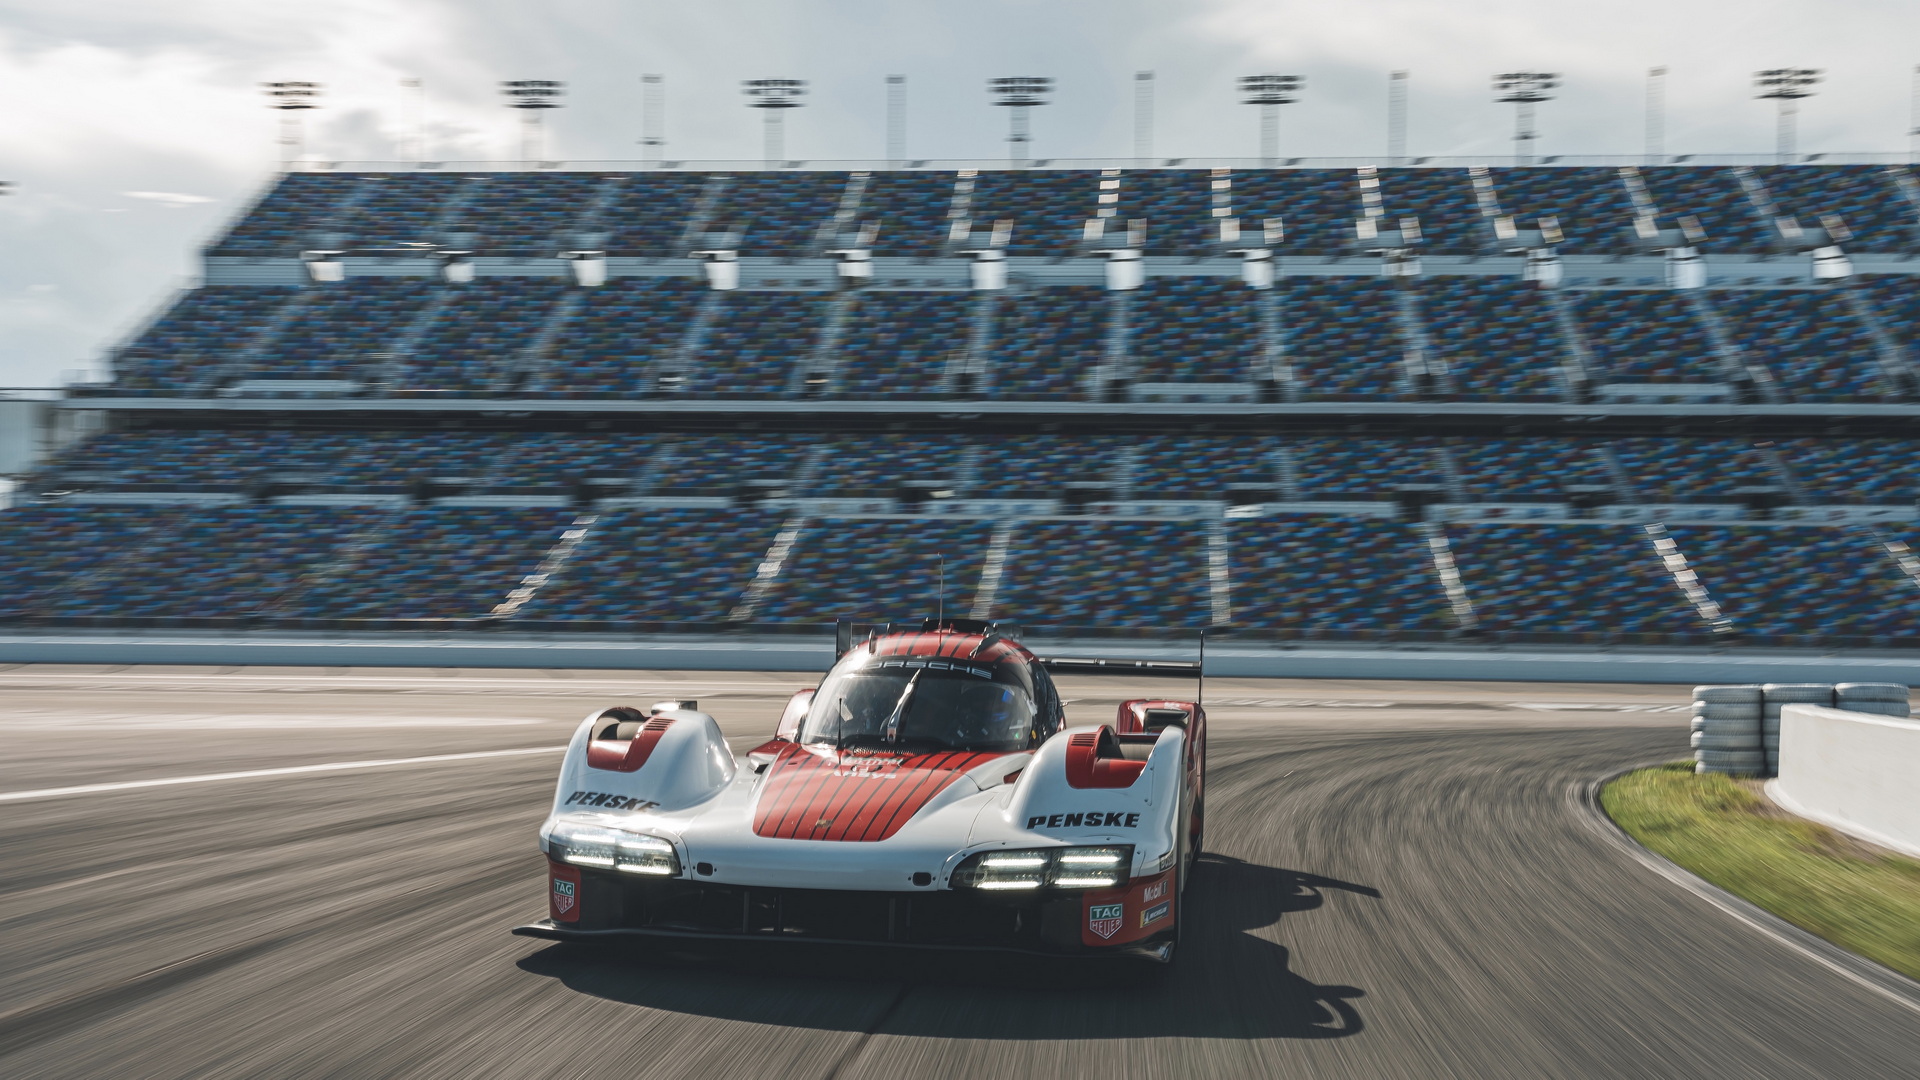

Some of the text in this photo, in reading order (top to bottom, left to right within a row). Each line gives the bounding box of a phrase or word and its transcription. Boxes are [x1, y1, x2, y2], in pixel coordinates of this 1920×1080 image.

[564, 791, 661, 812] PENSKE
[1026, 812, 1141, 830] PENSKE
[555, 881, 573, 895] TAG
[1143, 882, 1162, 903] Mobil
[1093, 906, 1120, 919] TAG
[1091, 919, 1121, 937] HEUER
